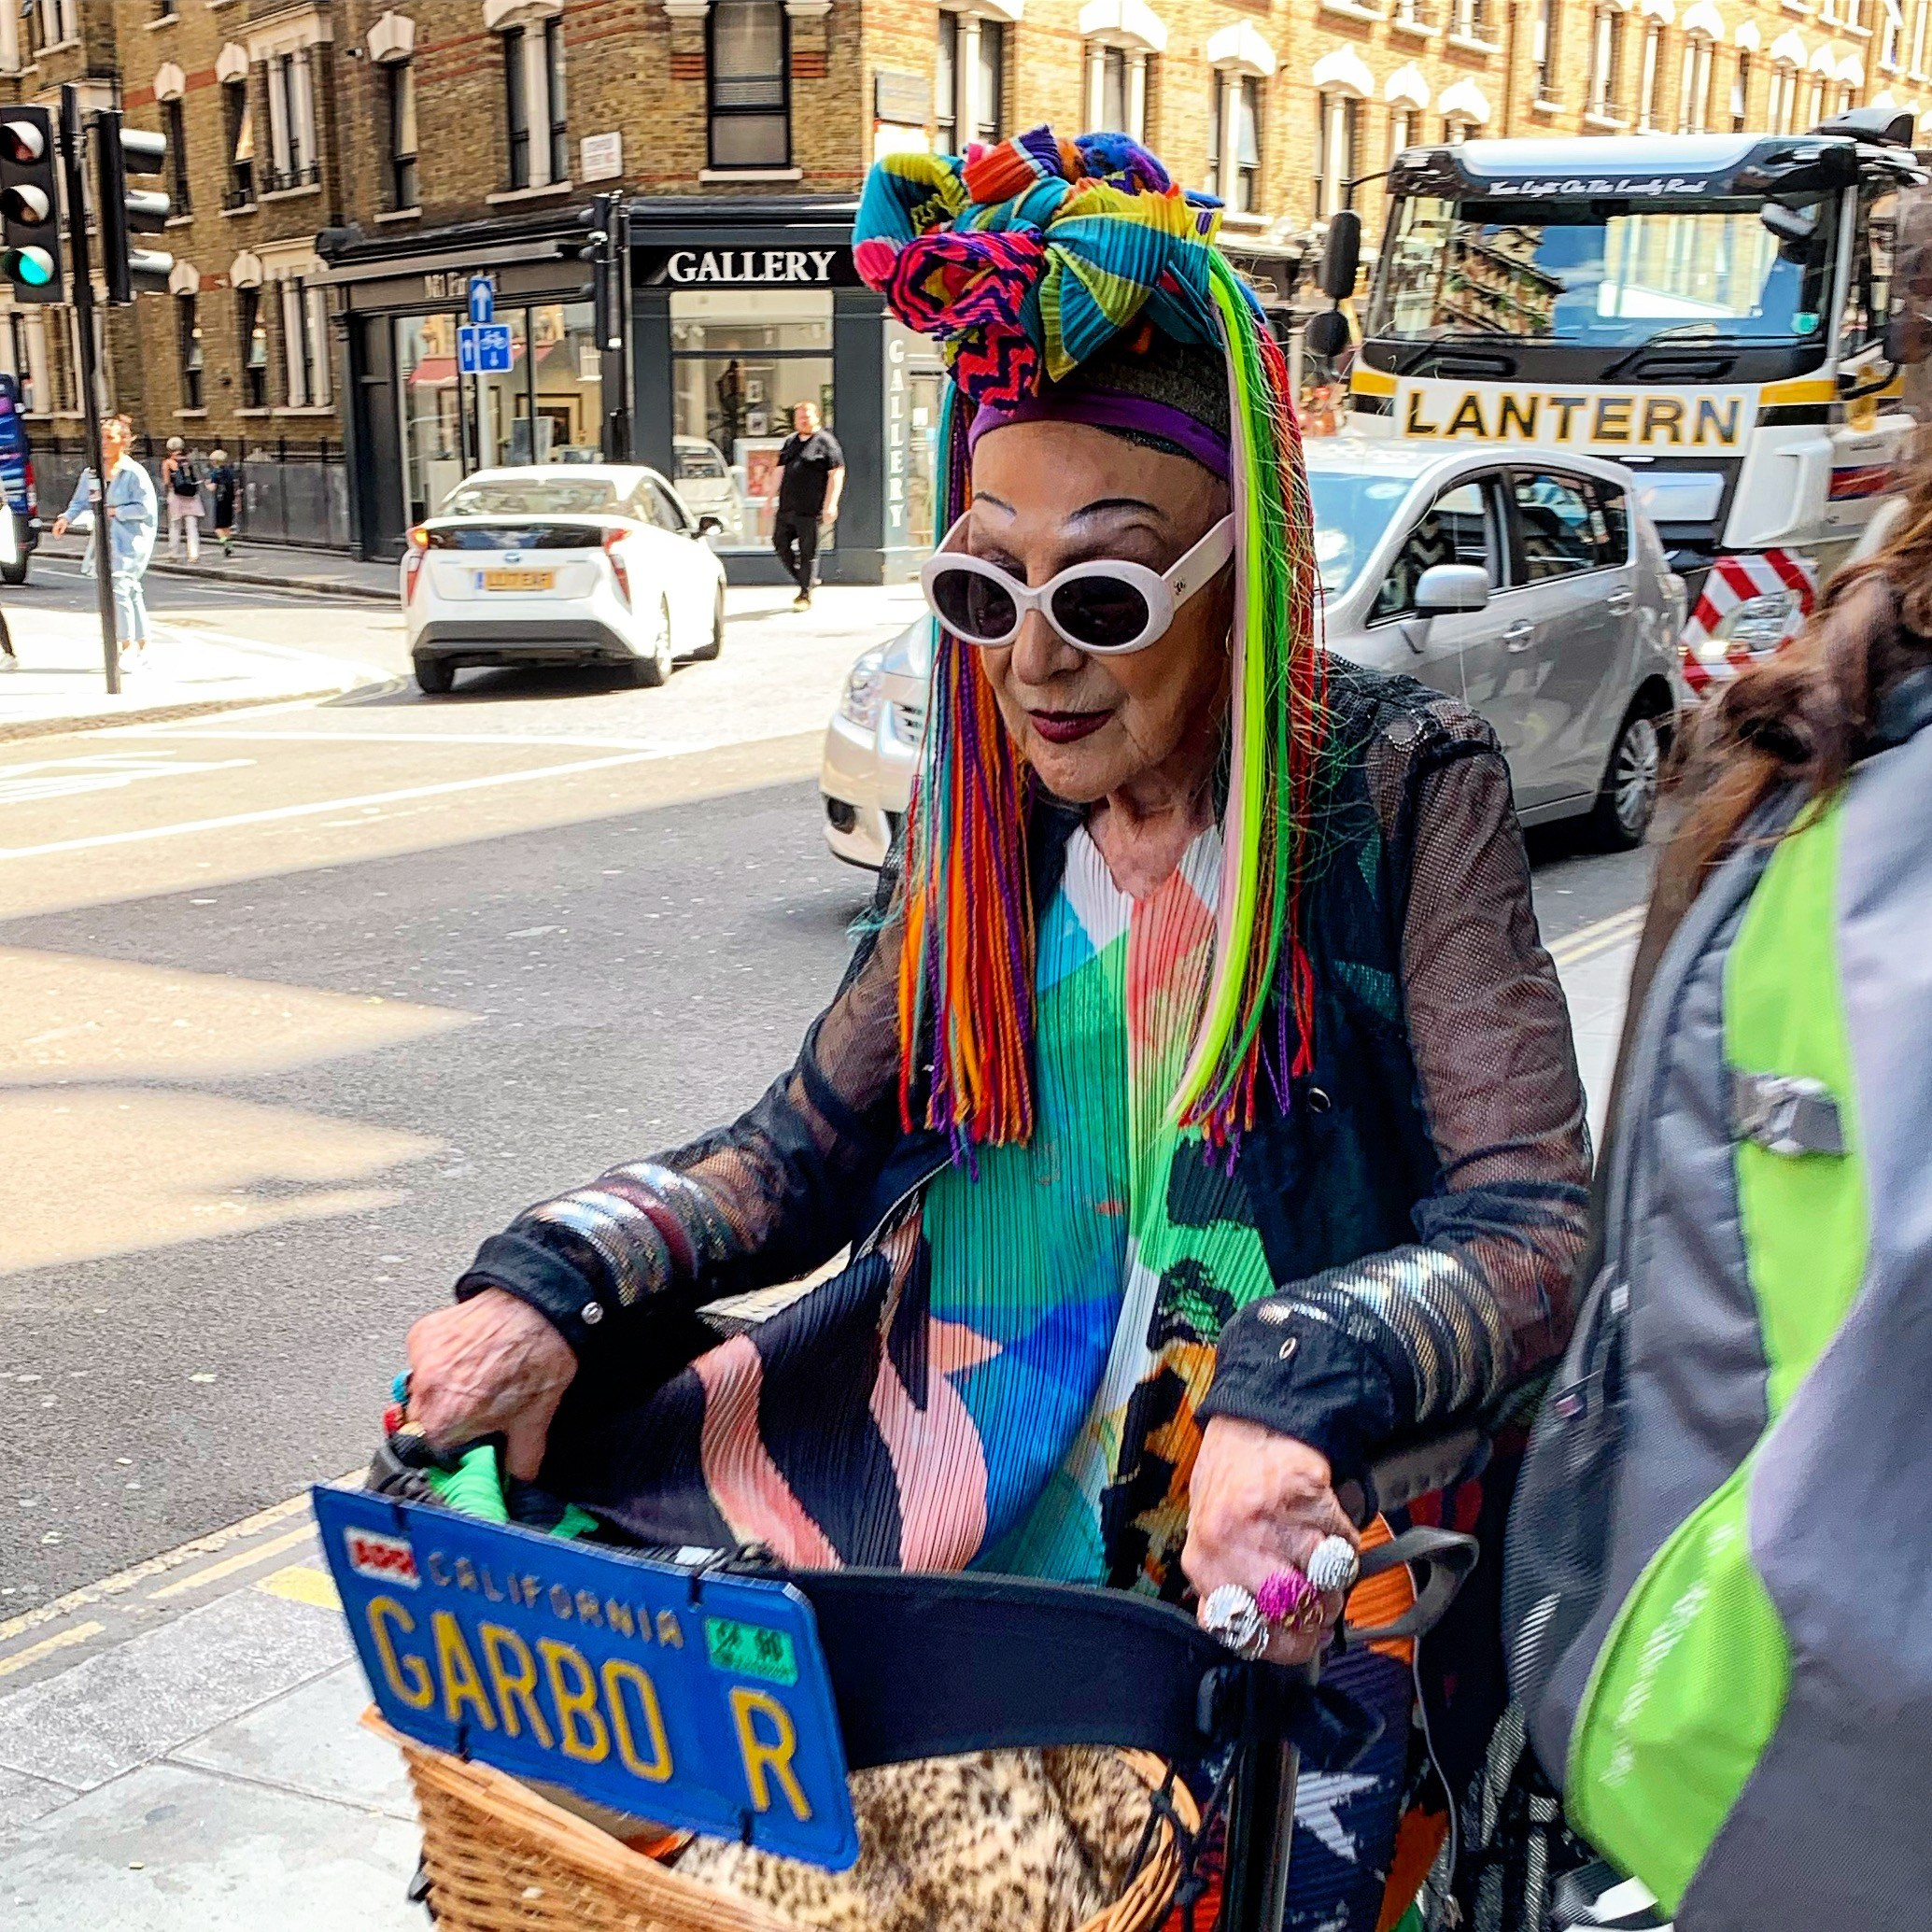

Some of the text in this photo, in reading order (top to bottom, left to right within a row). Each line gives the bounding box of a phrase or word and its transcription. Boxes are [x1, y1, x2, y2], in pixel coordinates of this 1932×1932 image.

[667, 250, 837, 282] GALLERY
[888, 339, 905, 528] GALLERY
[1405, 389, 1742, 445] LANTERN
[428, 1550, 683, 1650] CALIFORNIA
[365, 1595, 812, 1823] GARBO R
